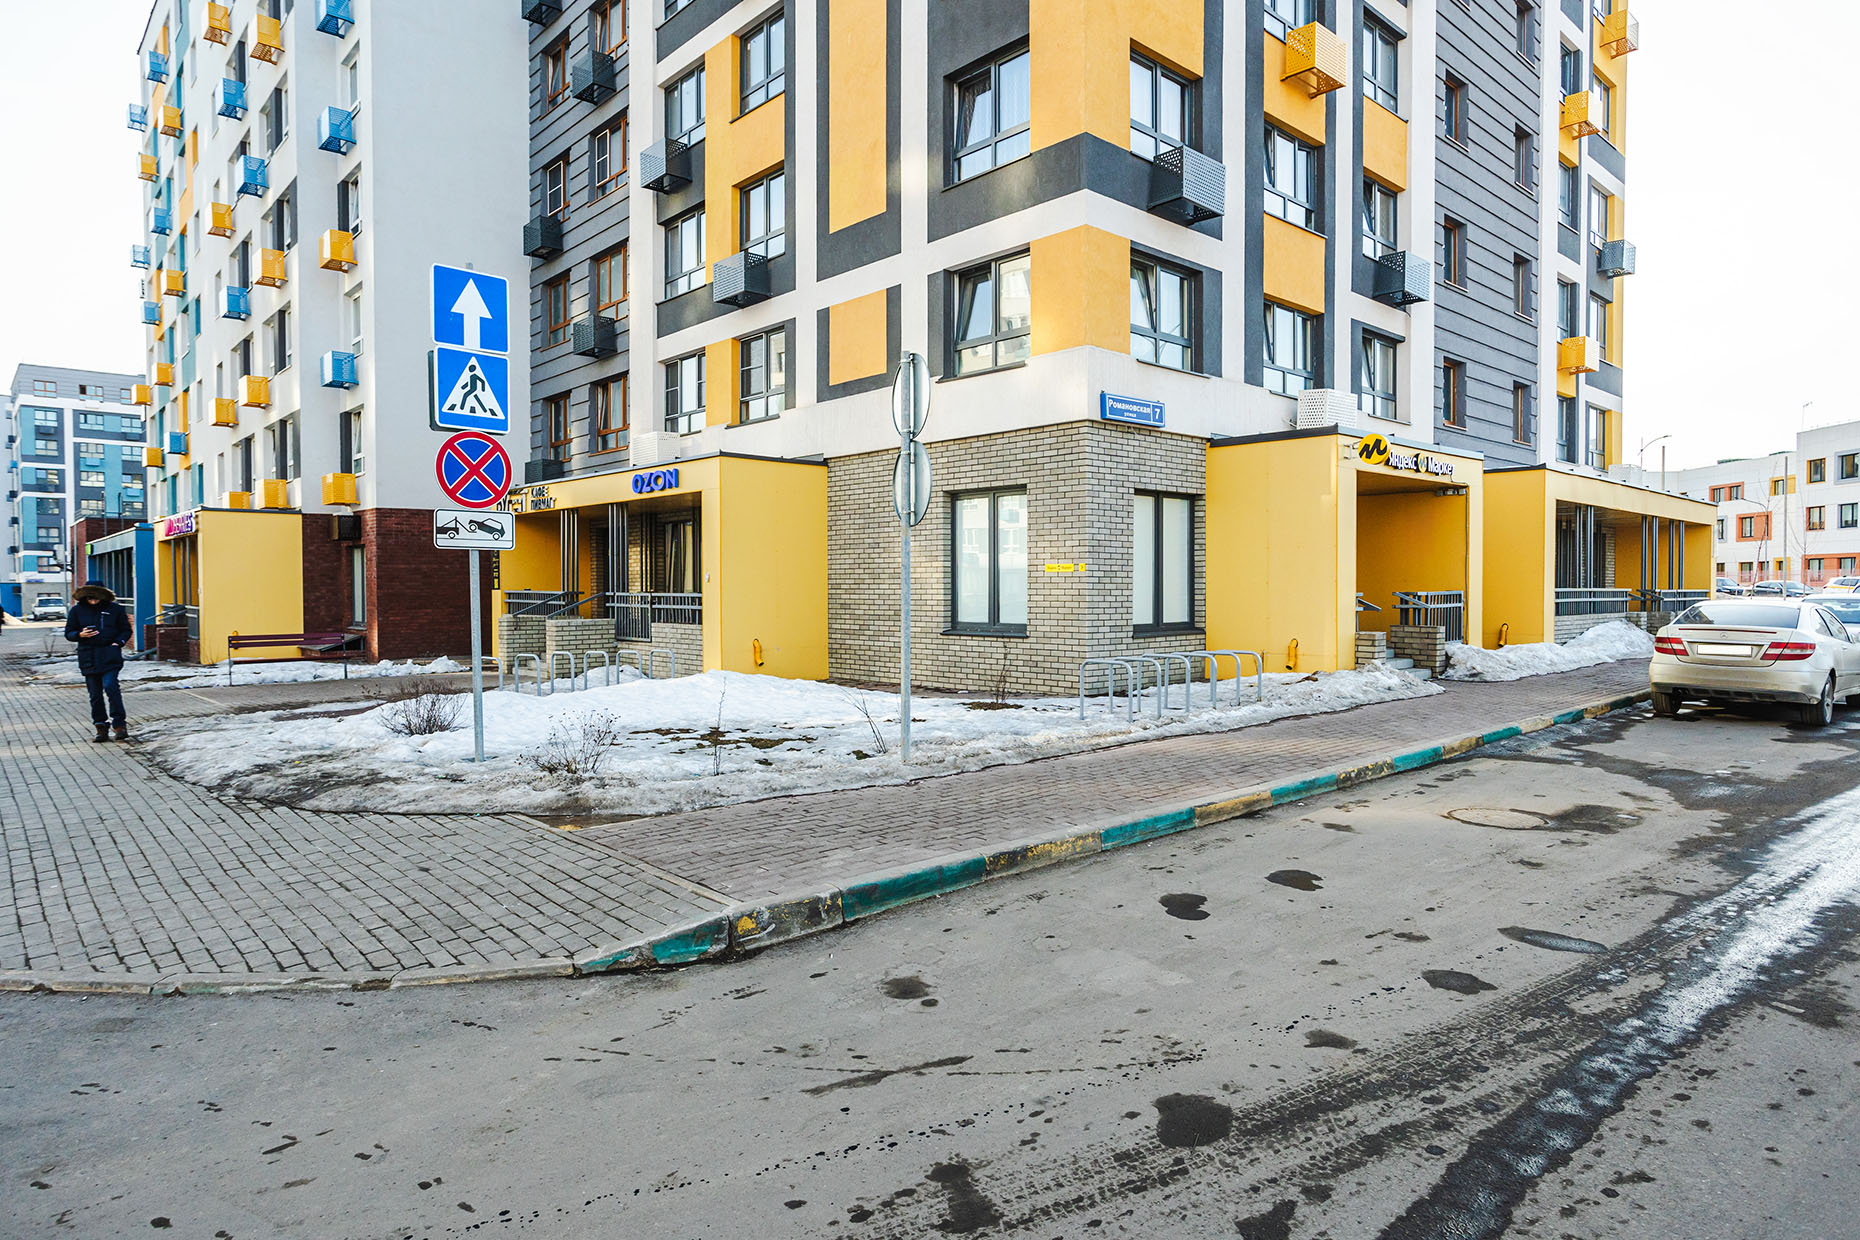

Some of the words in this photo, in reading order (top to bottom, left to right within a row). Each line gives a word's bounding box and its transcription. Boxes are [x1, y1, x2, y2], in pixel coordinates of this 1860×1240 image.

[1108, 399, 1150, 413] Романовская
[1154, 408, 1160, 419] 7
[1389, 450, 1417, 470] Яндекс
[1428, 456, 1455, 476] Маркет
[632, 468, 679, 494] OZON
